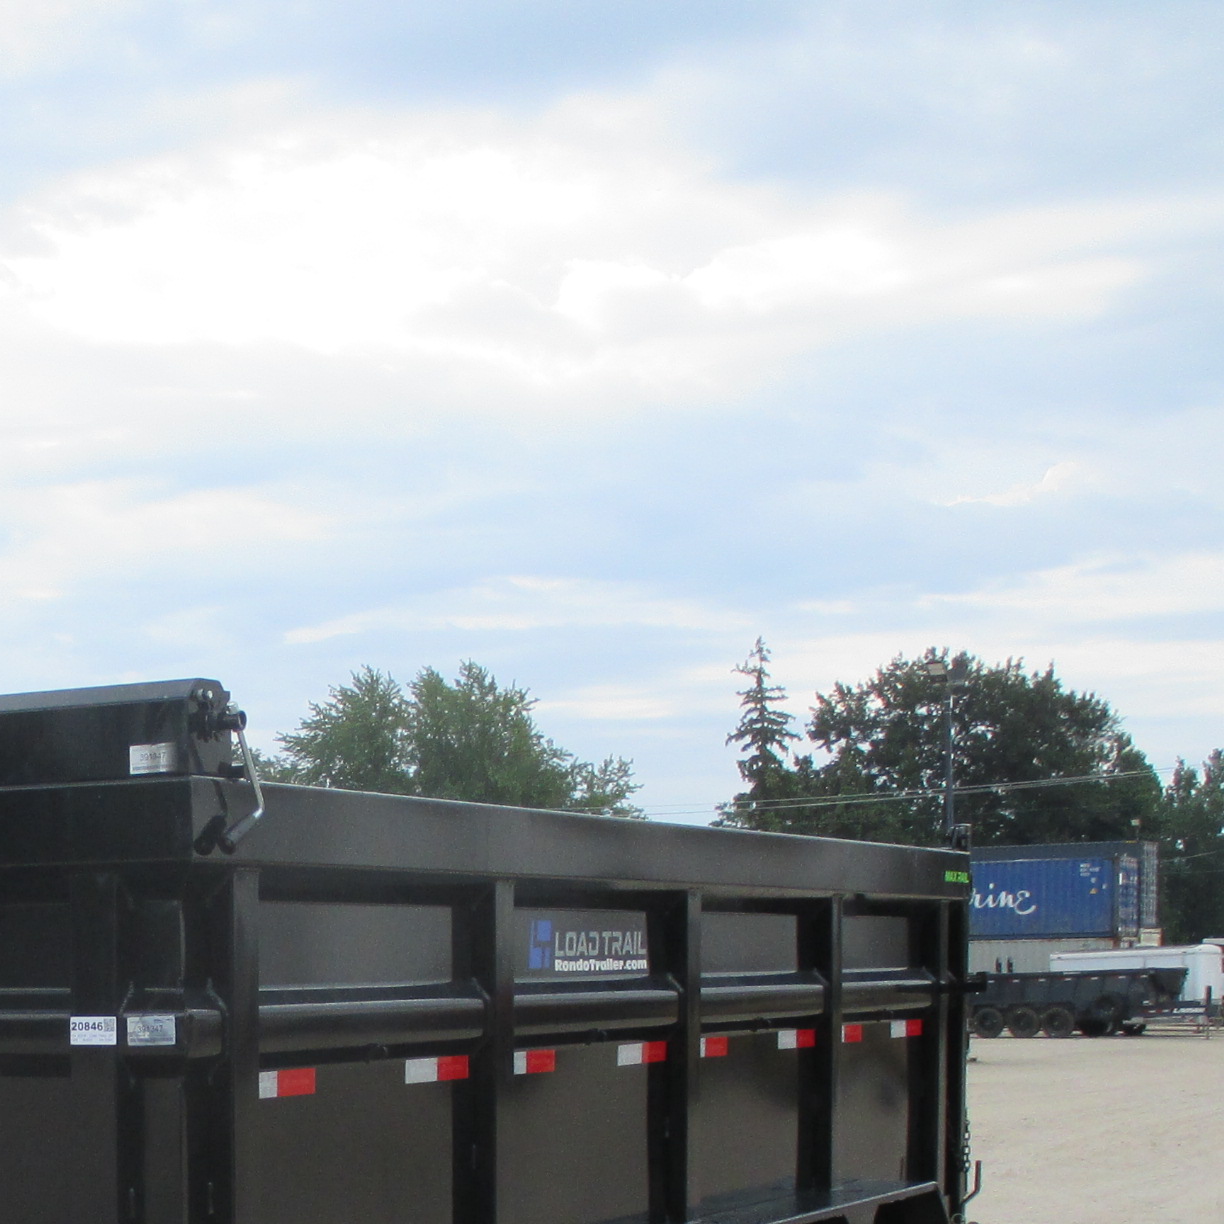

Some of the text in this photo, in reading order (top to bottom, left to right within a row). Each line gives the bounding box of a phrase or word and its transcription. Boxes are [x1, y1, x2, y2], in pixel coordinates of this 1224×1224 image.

[555, 931, 647, 956] LOAD TRAIL
[71, 1021, 104, 1032] 20846
